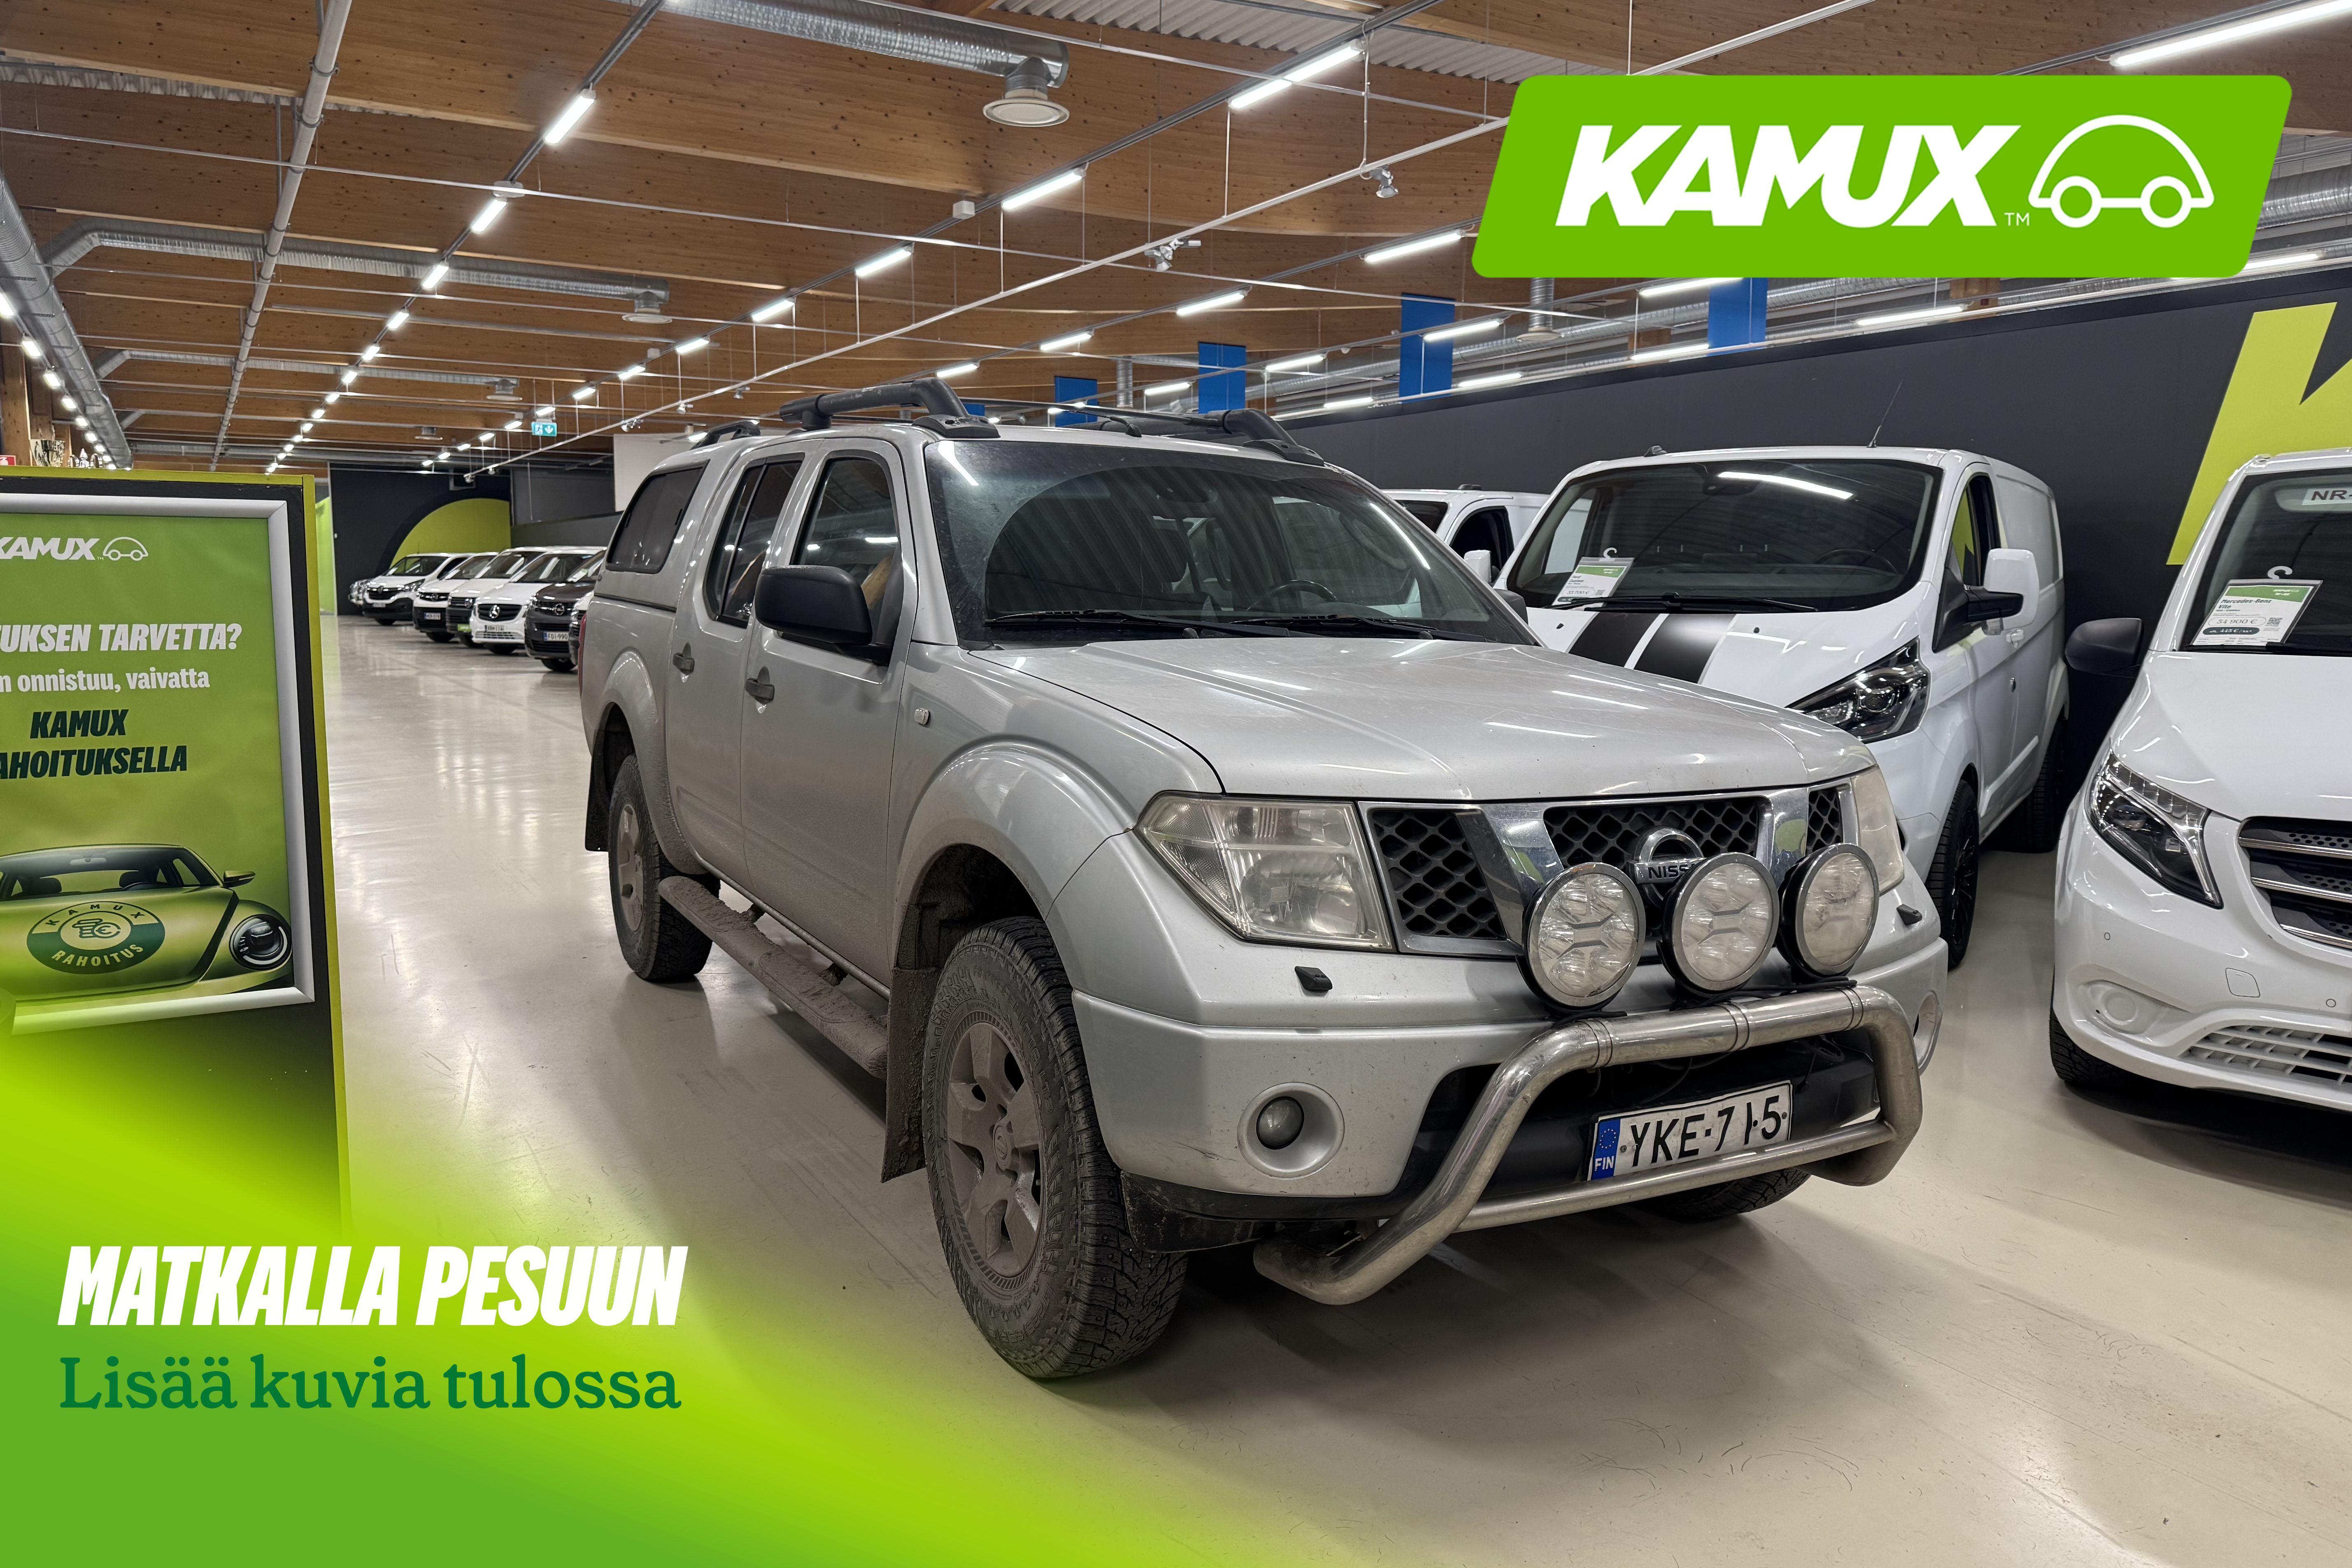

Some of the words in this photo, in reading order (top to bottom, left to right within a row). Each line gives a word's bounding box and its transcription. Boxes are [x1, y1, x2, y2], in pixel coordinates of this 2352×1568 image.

[0, 624, 91, 653] UKSEN
[99, 623, 242, 651] TARVETTA?
[17, 668, 121, 693] onnistuu,
[126, 667, 210, 689] vaivatta
[30, 709, 129, 739] KAMUX
[45, 904, 145, 926] KAMUX
[51, 944, 144, 966] RAHOITUS
[1594, 1156, 1615, 1171] FIN
